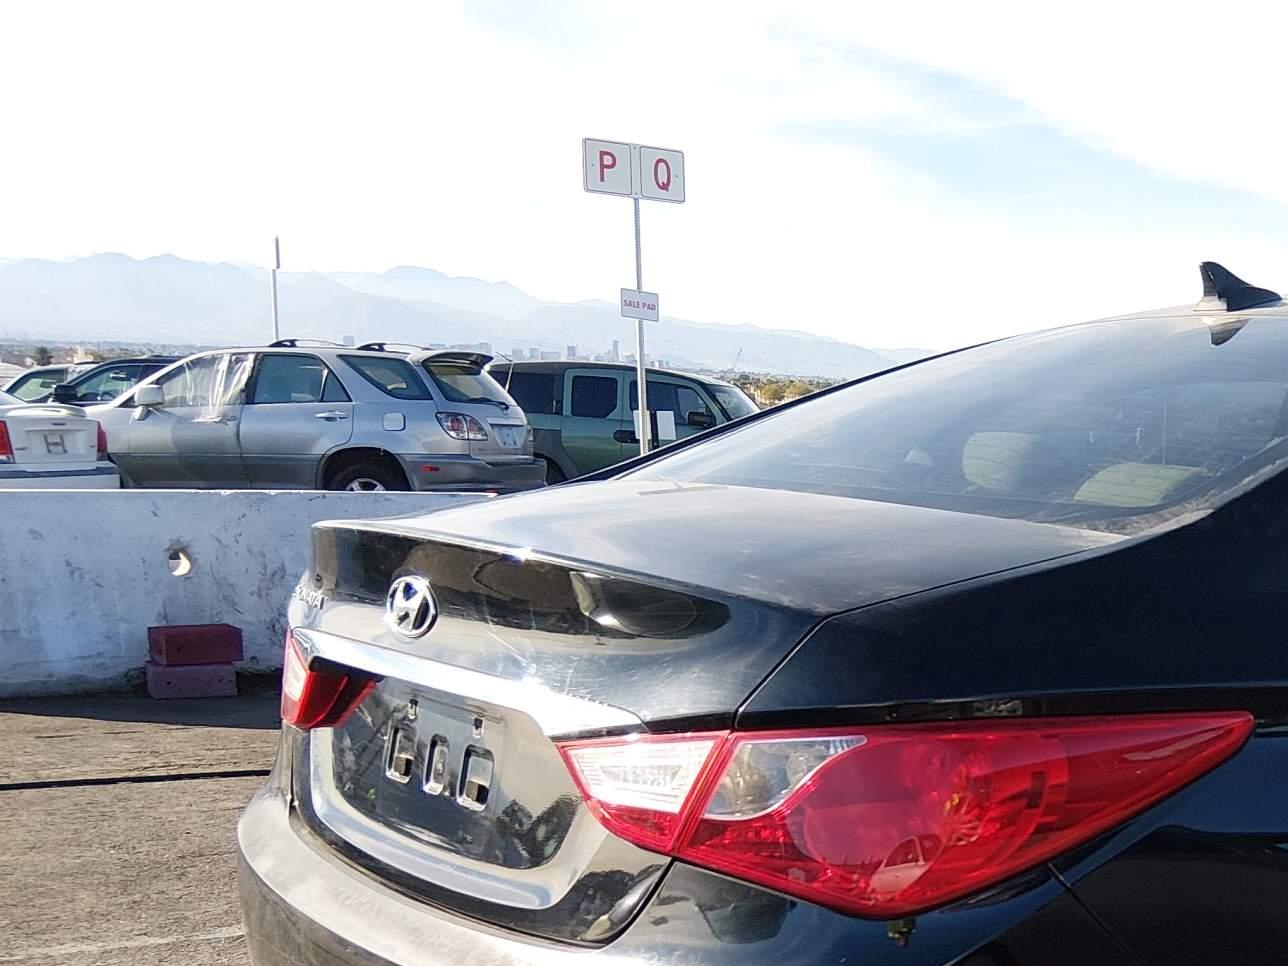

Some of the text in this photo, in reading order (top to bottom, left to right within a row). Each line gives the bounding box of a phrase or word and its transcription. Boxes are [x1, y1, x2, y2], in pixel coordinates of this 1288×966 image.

[599, 150, 617, 183] P
[653, 157, 671, 192] Q
[623, 299, 656, 311] SALE PAD
